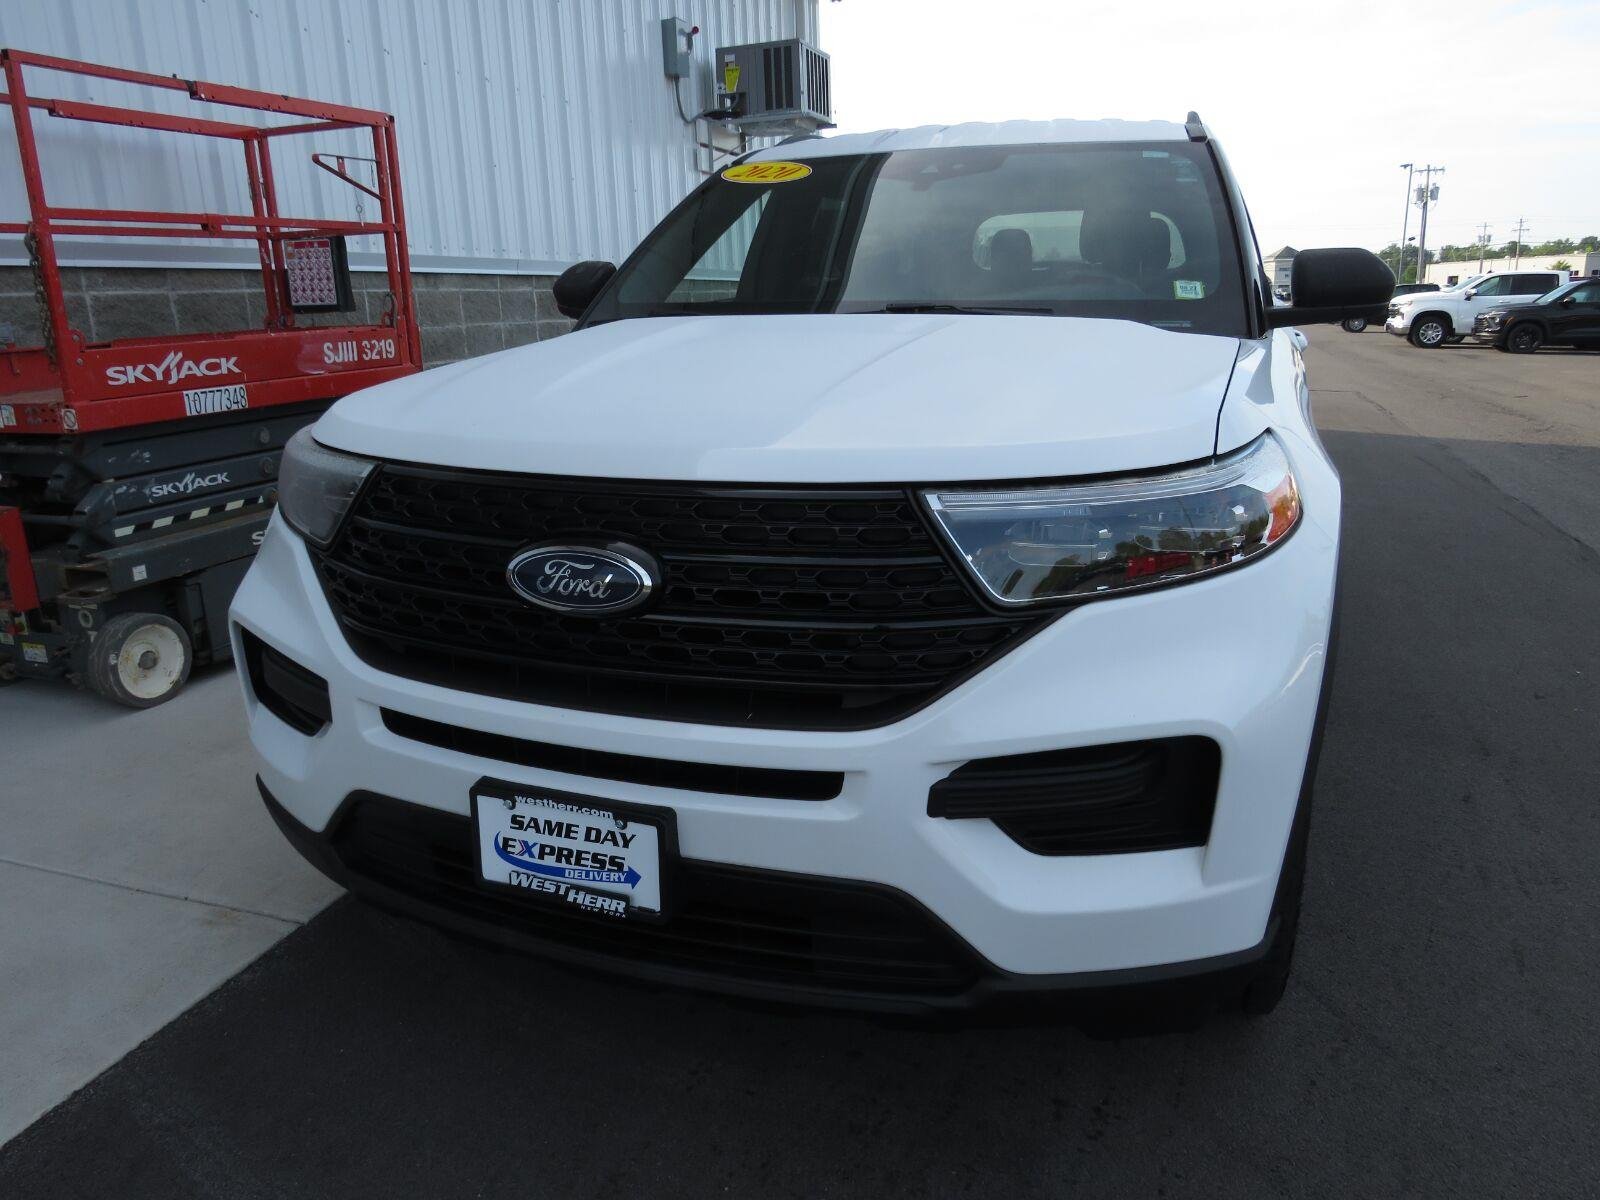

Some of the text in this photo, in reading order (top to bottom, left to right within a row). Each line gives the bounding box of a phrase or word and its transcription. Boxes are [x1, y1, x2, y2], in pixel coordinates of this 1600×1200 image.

[362, 339, 395, 360] 3219
[105, 350, 242, 386] SKYJACK
[185, 386, 248, 415] 10777348
[150, 472, 231, 498] SKYJACK
[536, 559, 614, 599] Ford
[515, 795, 614, 820] westherr.com
[509, 813, 637, 849] SAME DAY
[501, 836, 626, 872] EXPRESS
[564, 868, 627, 883] DELIVERY
